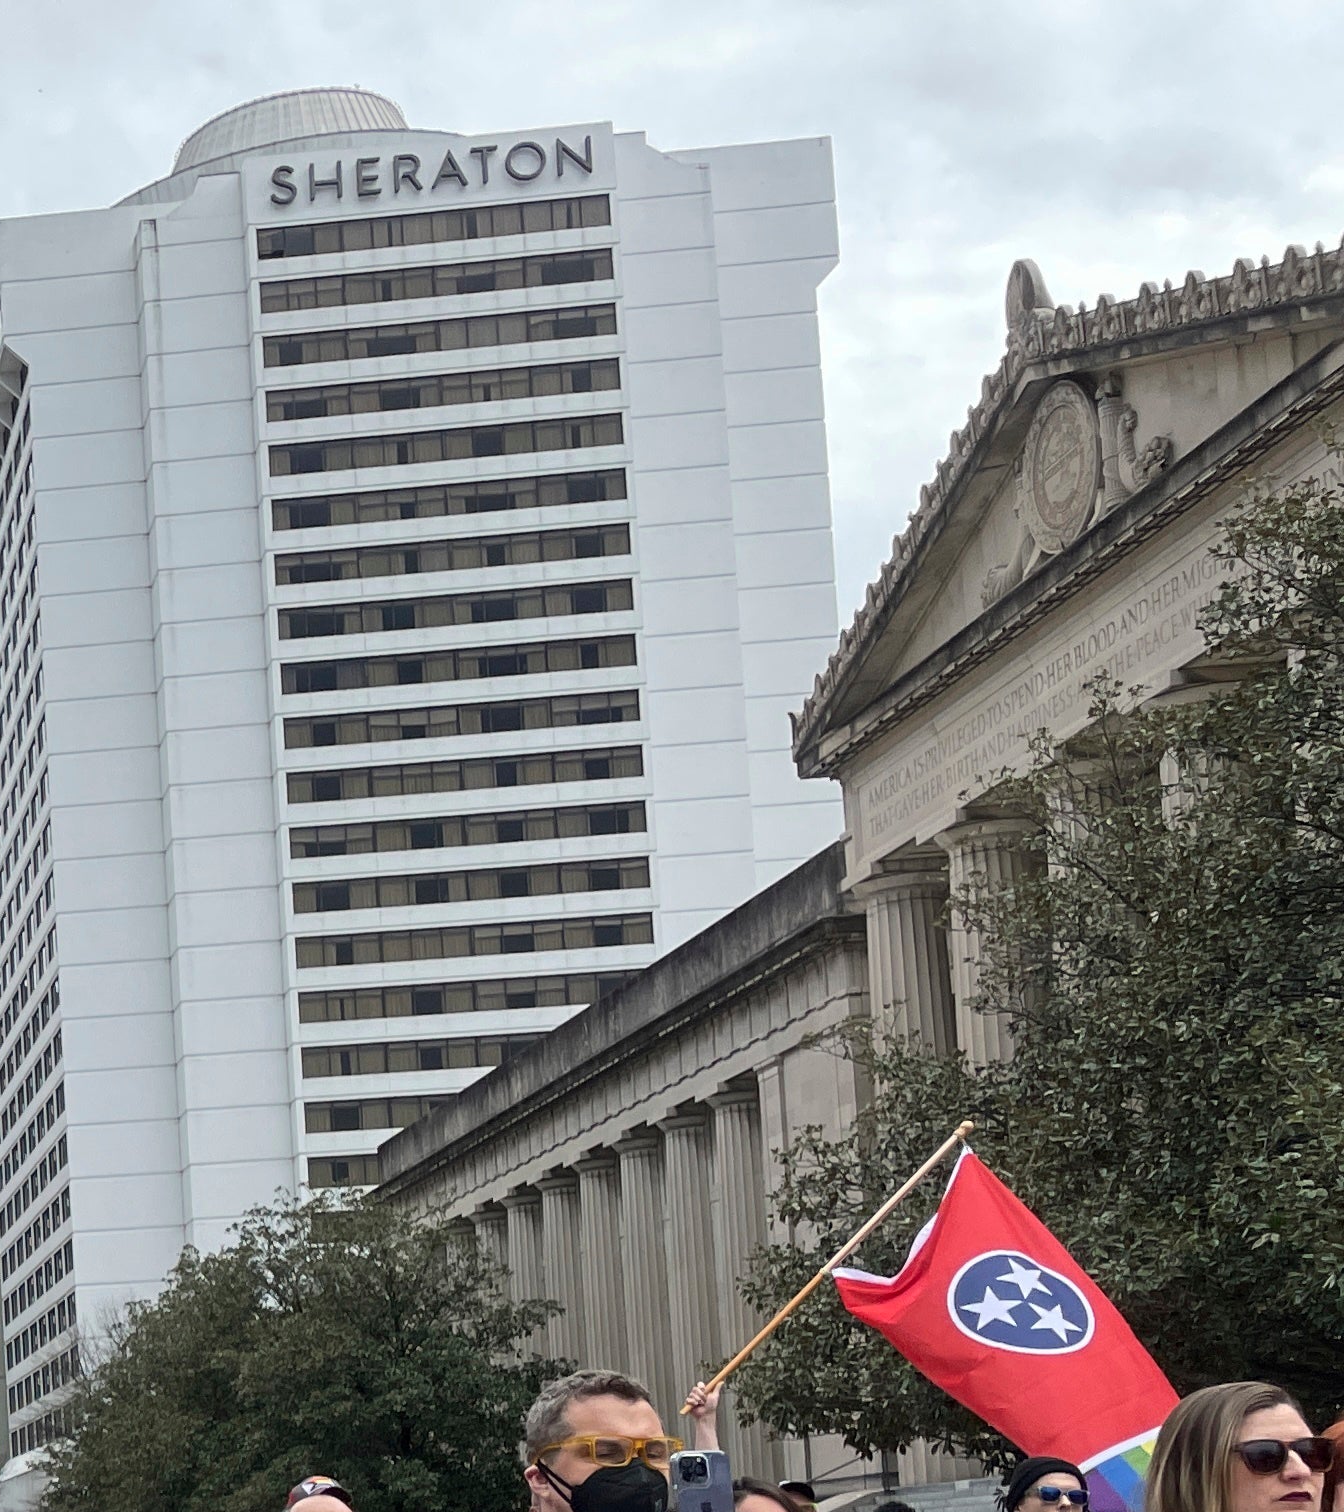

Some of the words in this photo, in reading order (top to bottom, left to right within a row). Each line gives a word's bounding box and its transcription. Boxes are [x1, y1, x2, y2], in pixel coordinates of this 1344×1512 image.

[270, 135, 593, 205] SHERATON
[868, 765, 912, 809] AMERICA
[924, 713, 987, 774] PRIVILEGED
[986, 703, 1004, 732] TO
[1003, 672, 1044, 721] SPEND
[1046, 655, 1074, 689] HER
[1073, 620, 1116, 668] BLOOD
[1119, 598, 1150, 640] AND
[1151, 575, 1182, 617] HER
[1181, 552, 1227, 590] MIG
[921, 774, 946, 811] HER
[945, 751, 979, 793] BIRTH
[980, 731, 1006, 770] AND
[1105, 643, 1133, 685] THE
[1135, 612, 1180, 661] PEACE
